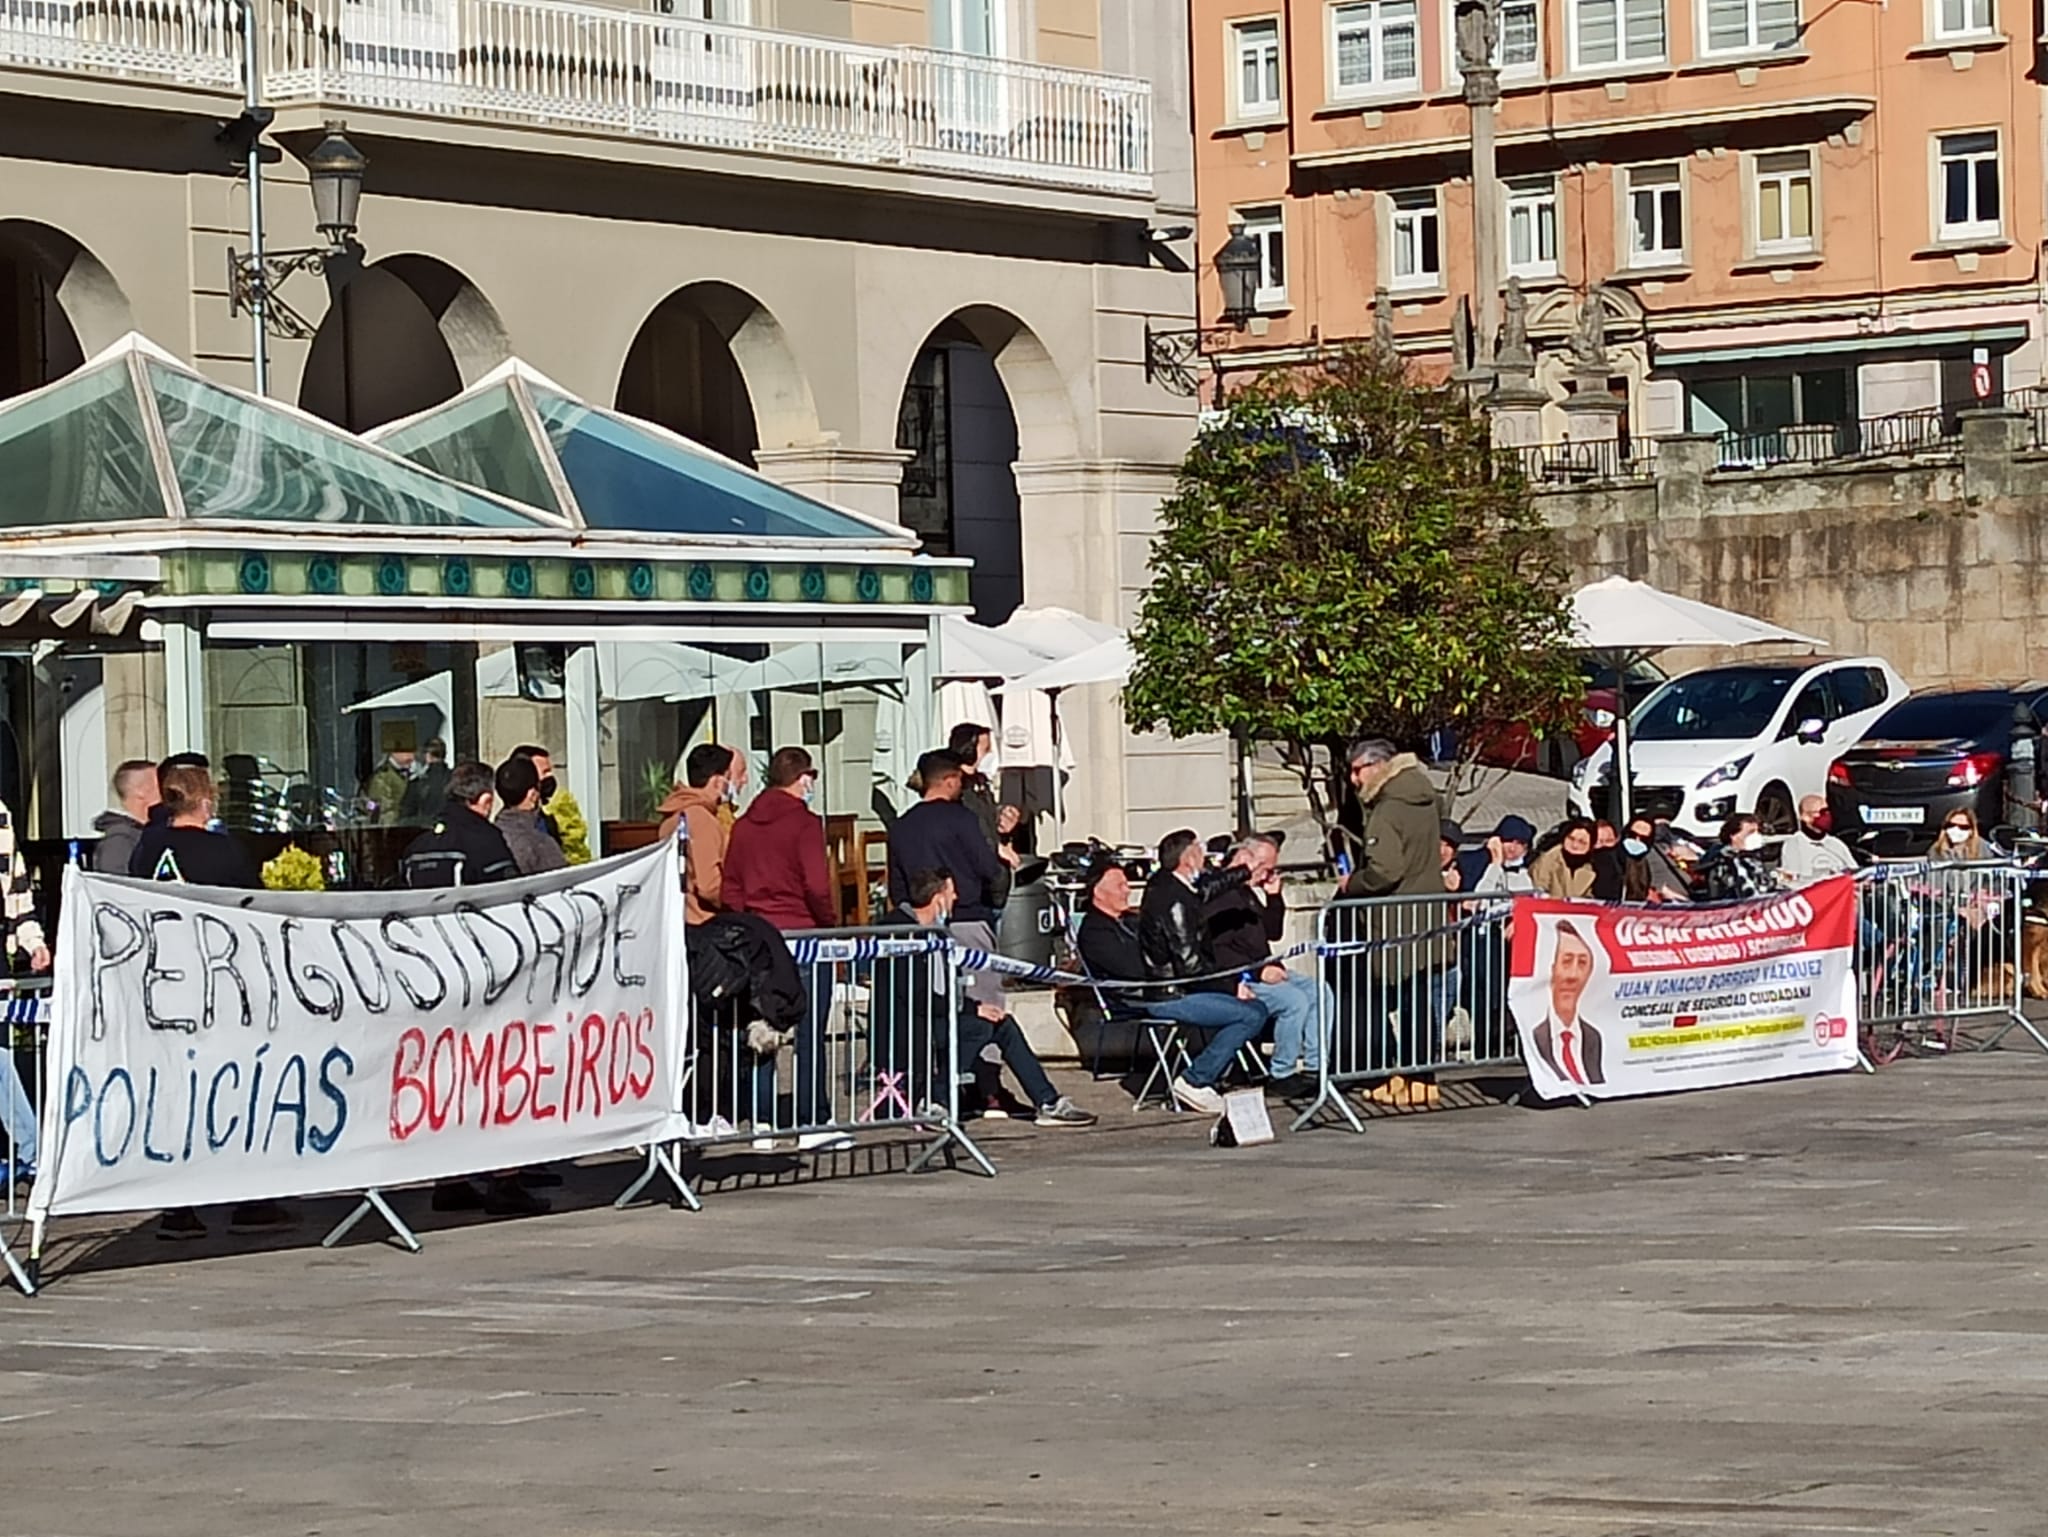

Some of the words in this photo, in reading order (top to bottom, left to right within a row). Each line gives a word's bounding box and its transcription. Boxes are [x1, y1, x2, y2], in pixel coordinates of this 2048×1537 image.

[89, 884, 647, 1041] PERIGOSIDADE
[1614, 979, 1653, 998] JUAN
[1654, 975, 1707, 995] IGNACIO
[1621, 1002, 1674, 1019] CONCEJAL
[1676, 999, 1690, 1013] DE
[1691, 993, 1747, 1012] SEGURIDAD
[1749, 985, 1812, 1005] CIUDADANA
